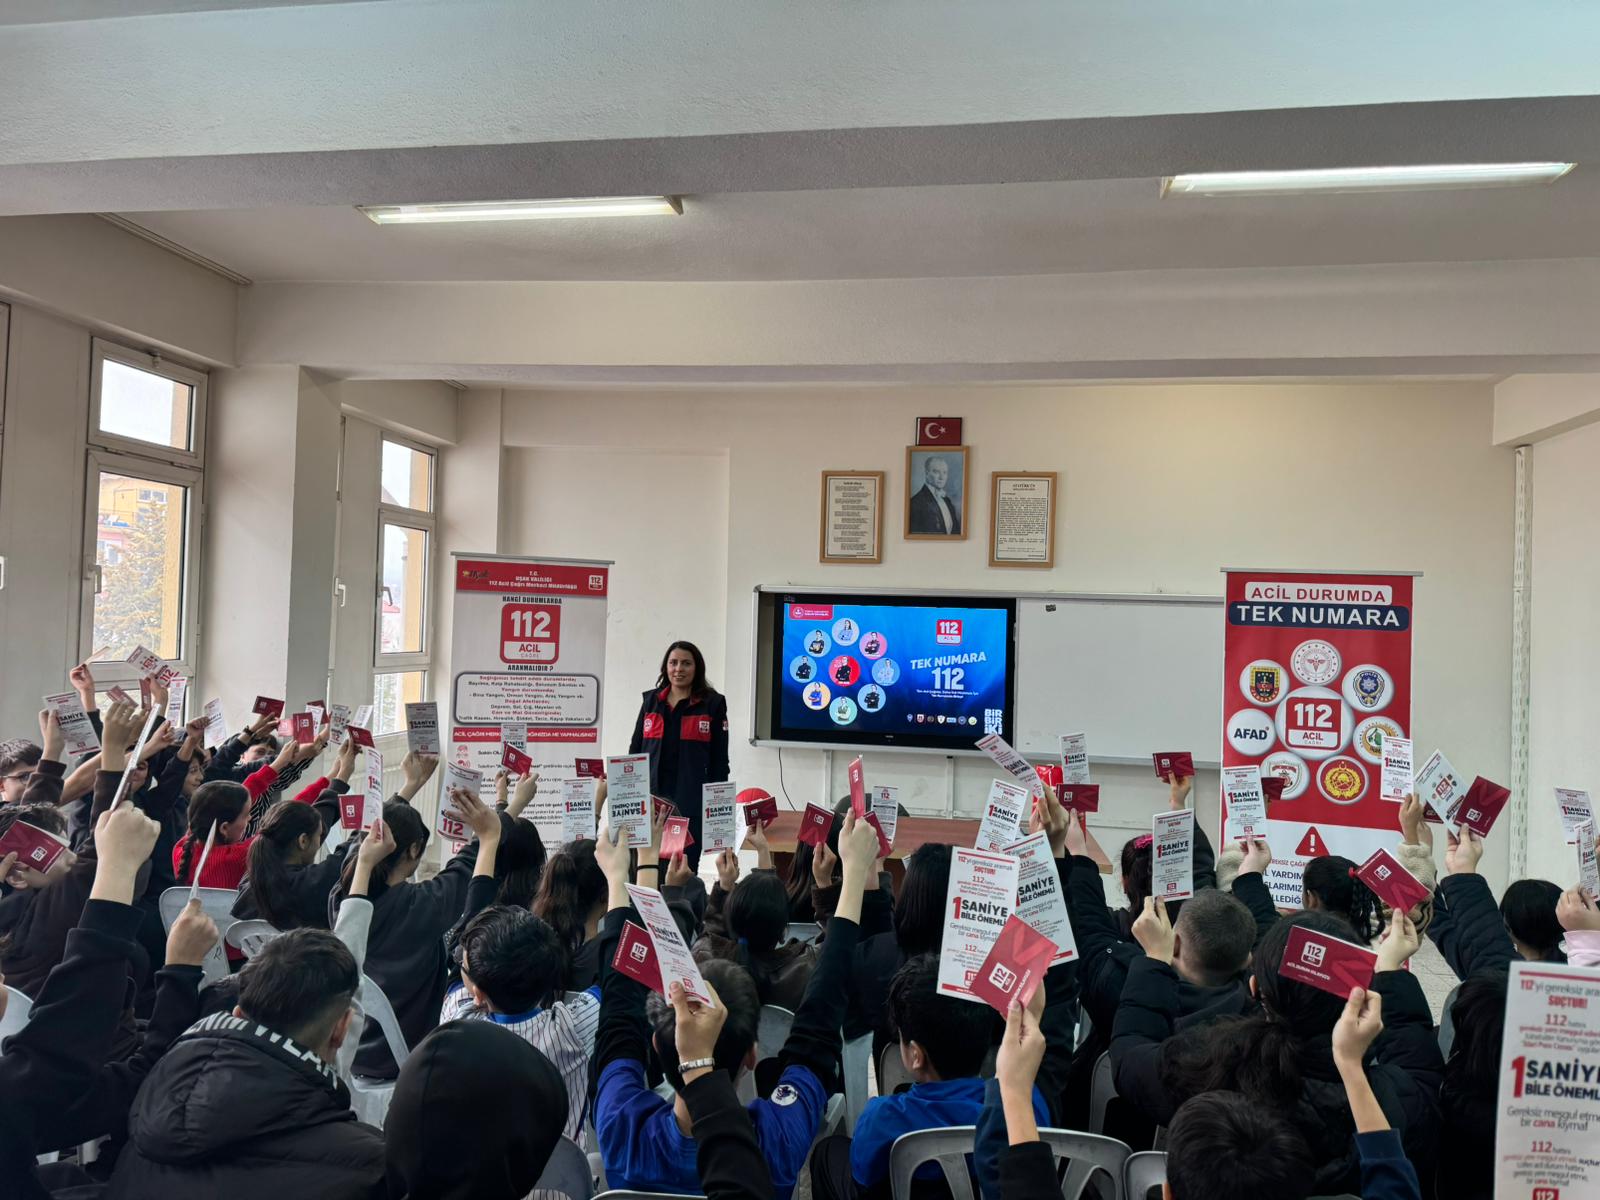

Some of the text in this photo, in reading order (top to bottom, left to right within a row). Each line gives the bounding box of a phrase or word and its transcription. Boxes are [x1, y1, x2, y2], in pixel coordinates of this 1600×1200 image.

[1252, 585, 1386, 602] ACİL DURUMDA
[1237, 605, 1400, 627] TEK NUMARA
[510, 610, 551, 638] 112
[940, 622, 958, 634] 112
[519, 643, 541, 653] ACİL
[910, 651, 987, 669] TEK NUMARA
[160, 668, 174, 682] 112
[931, 667, 964, 690] 112
[59, 712, 84, 721] SANİYE
[985, 708, 1002, 717] BİR
[1294, 703, 1333, 728] 112
[1234, 728, 1268, 741] AFAD
[1302, 732, 1324, 740] ACİL
[1064, 754, 1068, 765] 1
[1384, 757, 1411, 768] 1 SANİYE
[1437, 780, 1448, 794] 112
[1228, 790, 1259, 804] 1 SANİYE
[565, 800, 570, 813] 1
[612, 808, 641, 818] SANİYE
[705, 807, 710, 819] 1
[989, 804, 1018, 820] 1 SANİYE
[1567, 805, 1590, 814] SANİYE
[443, 818, 464, 836] 112
[1157, 840, 1189, 858] 1 SANİYE
[1379, 867, 1389, 875] 112
[972, 876, 985, 884] 112
[1018, 876, 1054, 896] SANİYE
[1020, 887, 1055, 904] BİLE ÖNEMLİ
[1271, 894, 1301, 904] LLEDİĞ
[953, 896, 1008, 920] 1 SANİYE
[961, 911, 1006, 926] BİLE ÖNEMLİ
[950, 922, 991, 937] Gereksiz meşgul
[634, 944, 645, 955] 112
[965, 944, 977, 952] 112
[1307, 945, 1321, 958] 112
[993, 968, 1007, 984] 112
[1544, 984, 1583, 994] gereksiz
[1584, 988, 1600, 996] ara
[1548, 995, 1588, 1009] SUÇTUR!
[1545, 1014, 1568, 1026] 112
[1512, 1056, 1526, 1098] 1
[1525, 1081, 1600, 1100] BİLE ÖNEML
[1507, 1106, 1578, 1121] Gereksiz meşgul
[1520, 1118, 1588, 1132] bir cana kıyma!
[1531, 1141, 1553, 1153] 112
